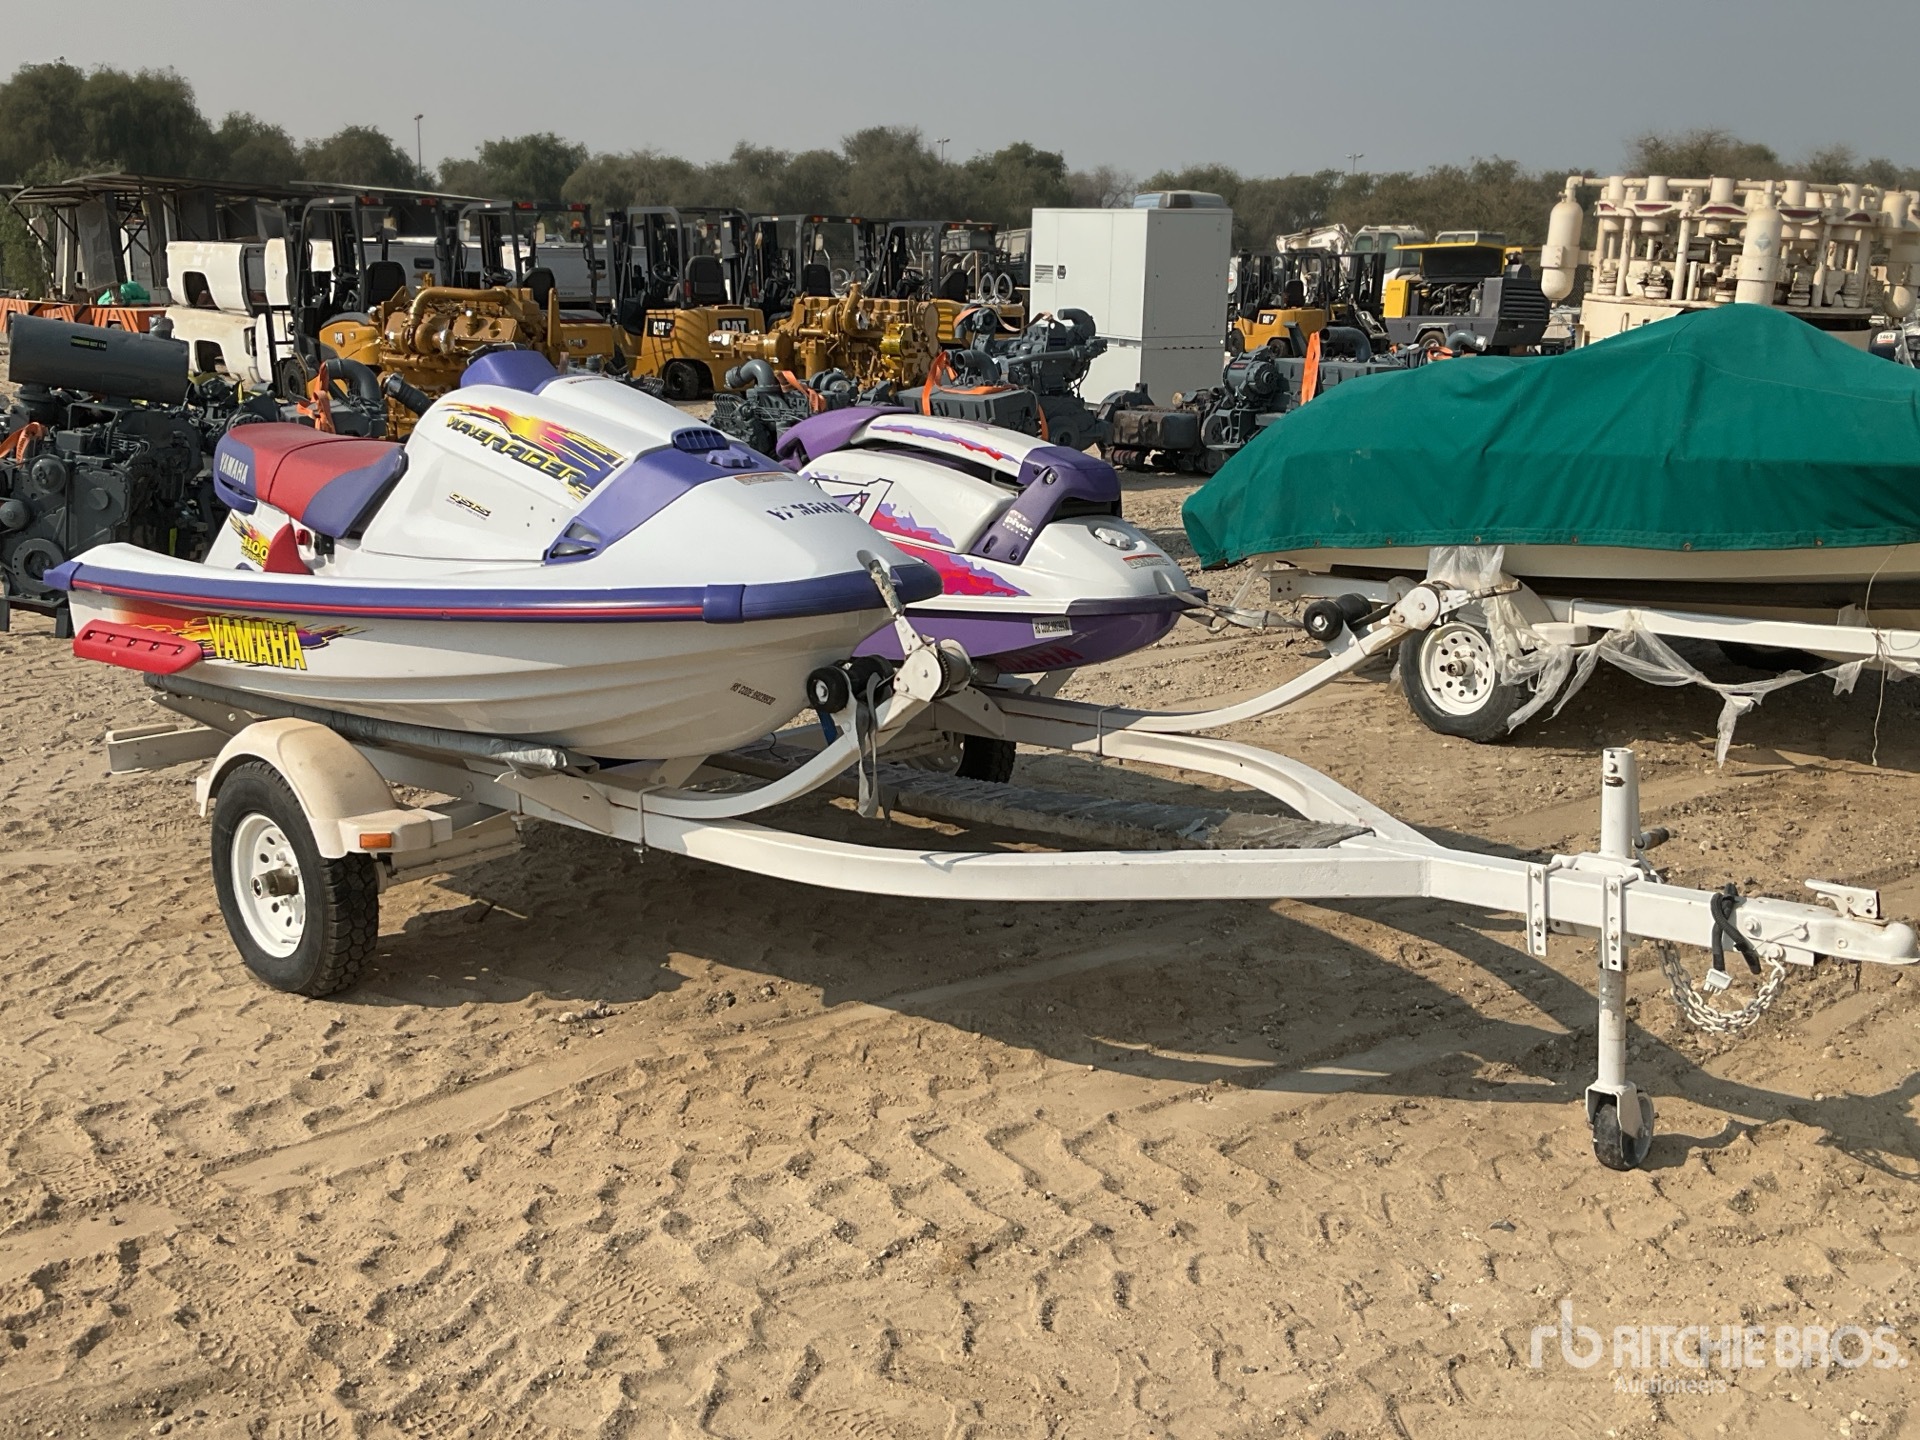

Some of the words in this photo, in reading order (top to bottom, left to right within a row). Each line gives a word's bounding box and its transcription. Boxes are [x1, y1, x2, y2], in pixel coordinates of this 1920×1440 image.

[654, 321, 666, 335] CAT
[721, 321, 746, 333] CAT
[220, 452, 249, 485] YAMAHA
[1004, 515, 1034, 536] pivot
[244, 534, 269, 560] 1100
[207, 615, 307, 670] YAMAHA
[730, 682, 741, 692] HS
